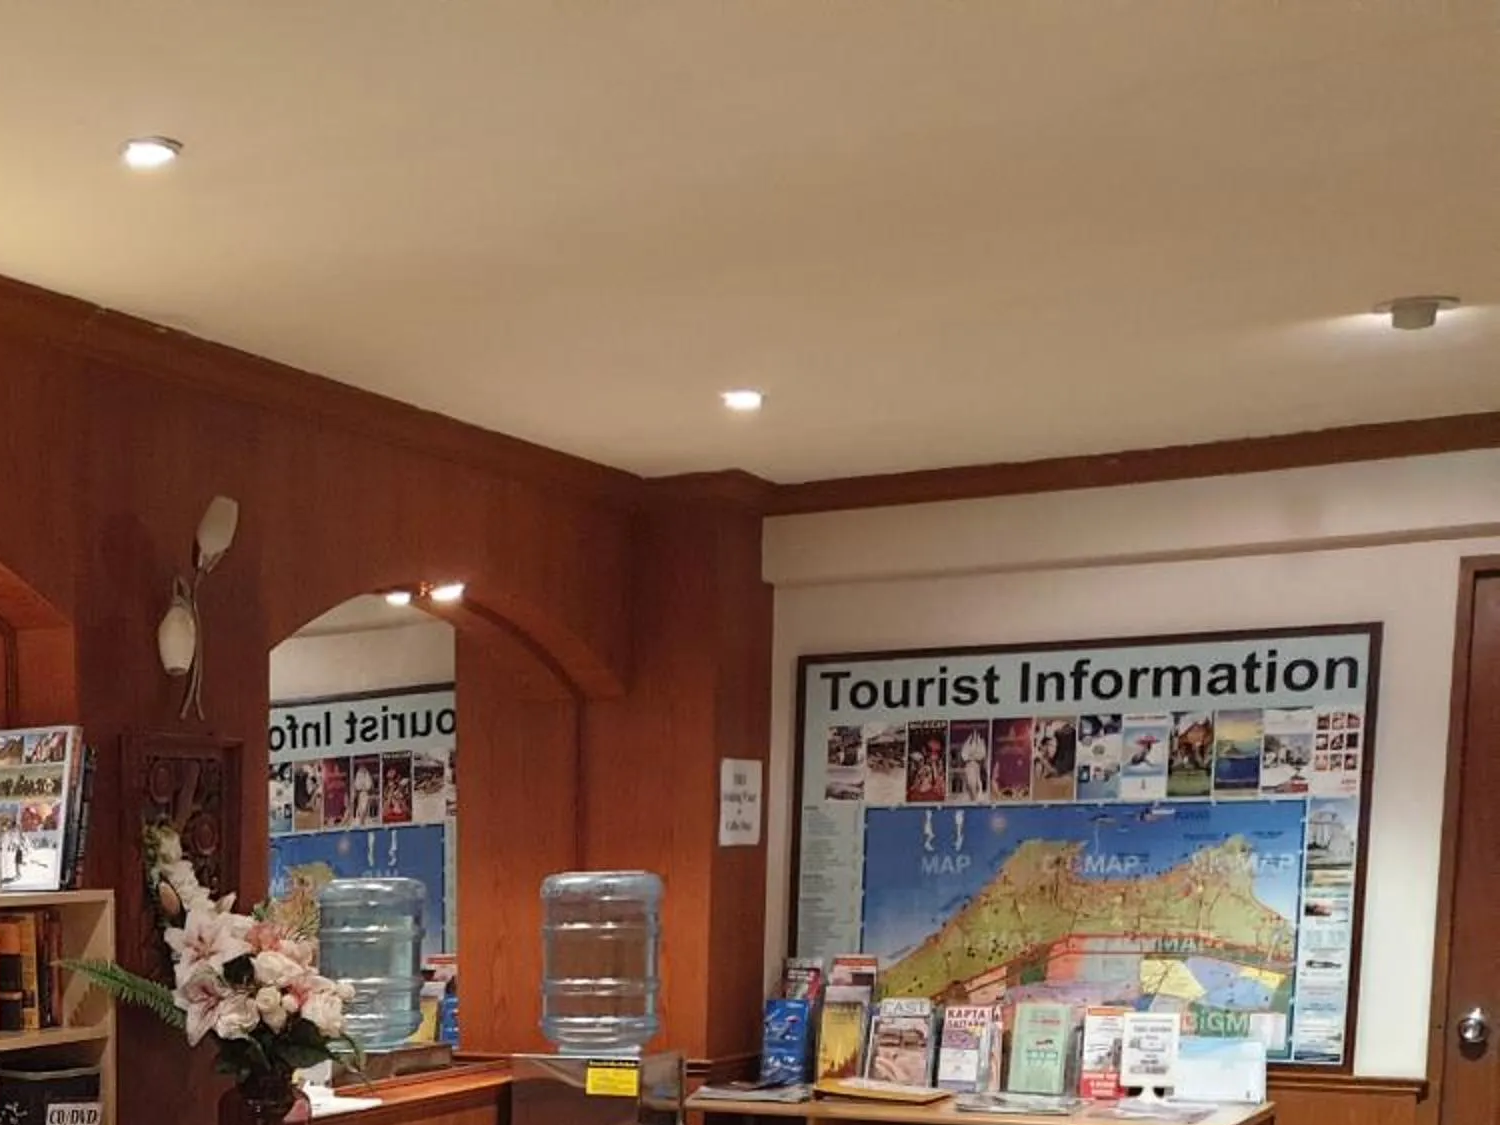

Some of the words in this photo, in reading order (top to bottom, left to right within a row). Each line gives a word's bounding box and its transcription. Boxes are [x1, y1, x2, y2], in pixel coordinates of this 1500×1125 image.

[820, 665, 1001, 711] Tourist
[1020, 649, 1360, 704] Information
[921, 854, 972, 875] MAP
